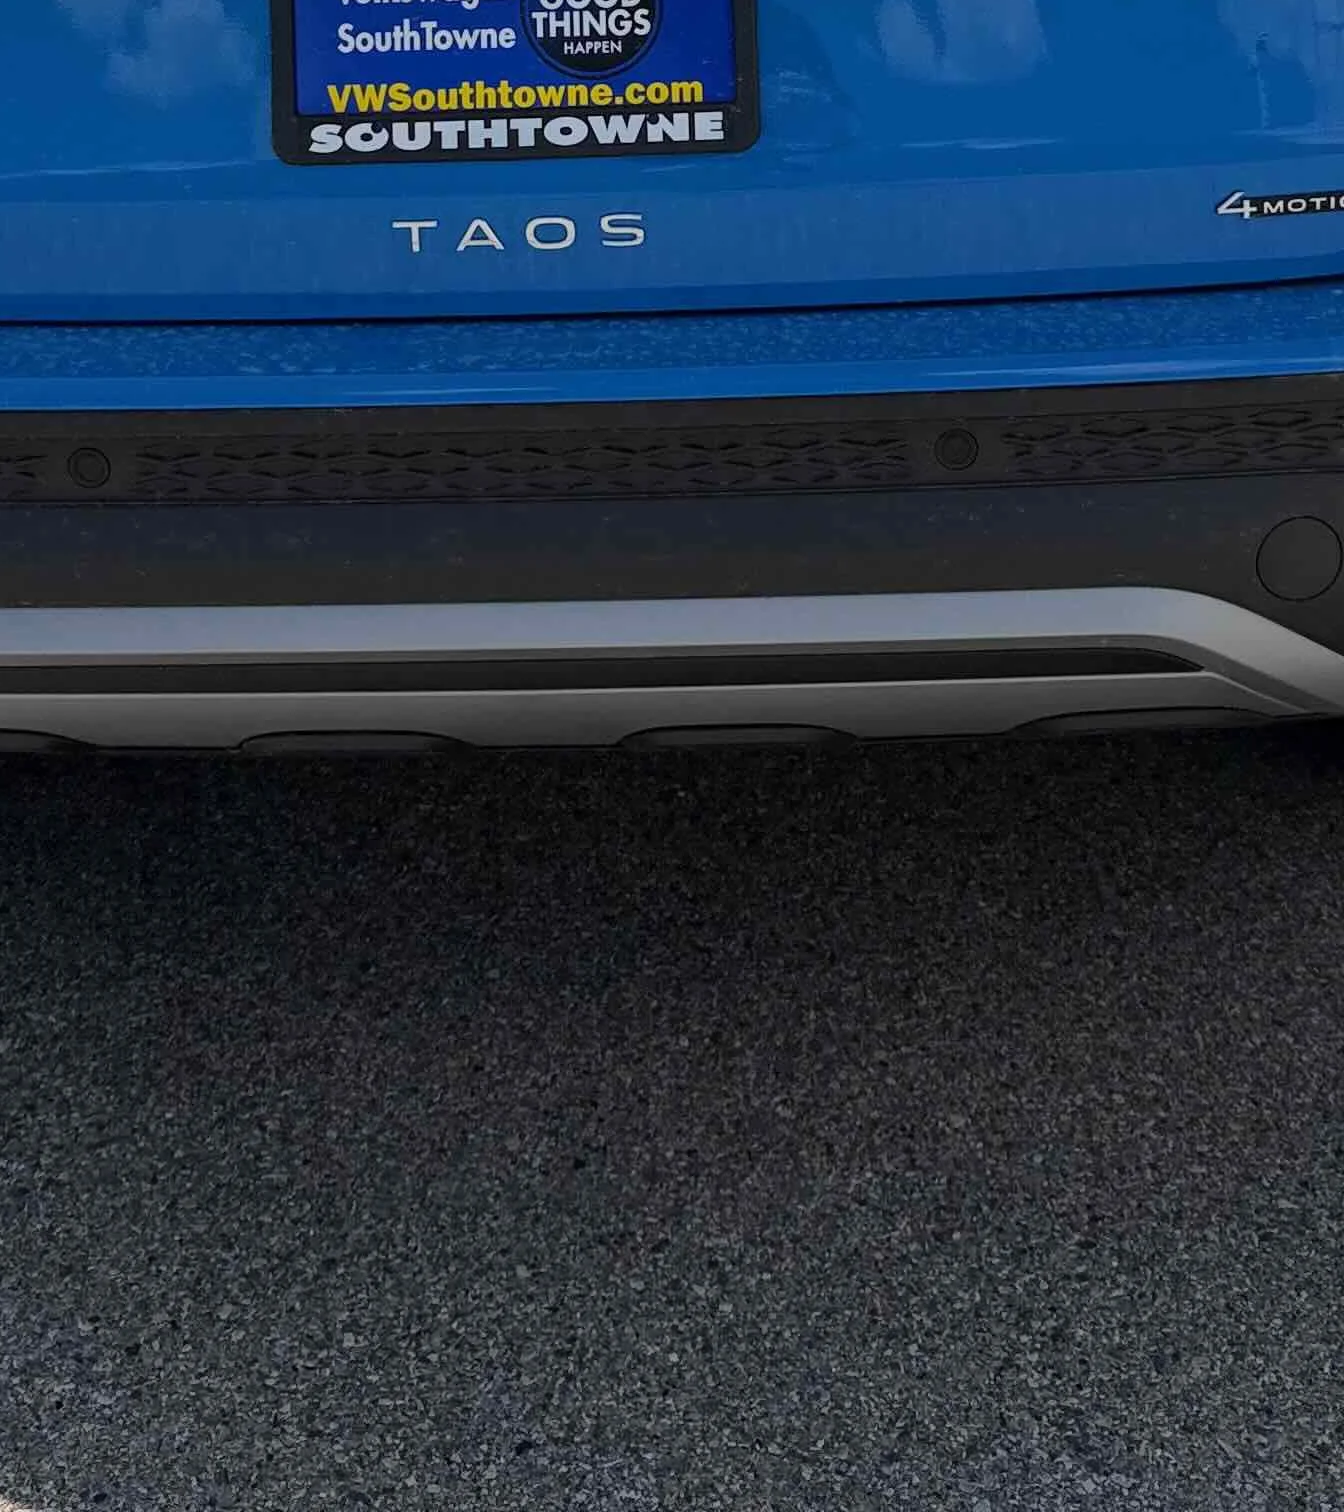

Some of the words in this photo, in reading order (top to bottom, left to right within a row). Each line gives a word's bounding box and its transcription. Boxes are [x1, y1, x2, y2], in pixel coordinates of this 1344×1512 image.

[336, 18, 517, 54] SouthTowne
[531, 7, 652, 39] THINGS
[563, 40, 623, 55] HAPPEN
[327, 78, 704, 114] VWSouthtowne.com
[308, 110, 725, 154] SOUTHTOWNE
[391, 213, 646, 253] TAOS
